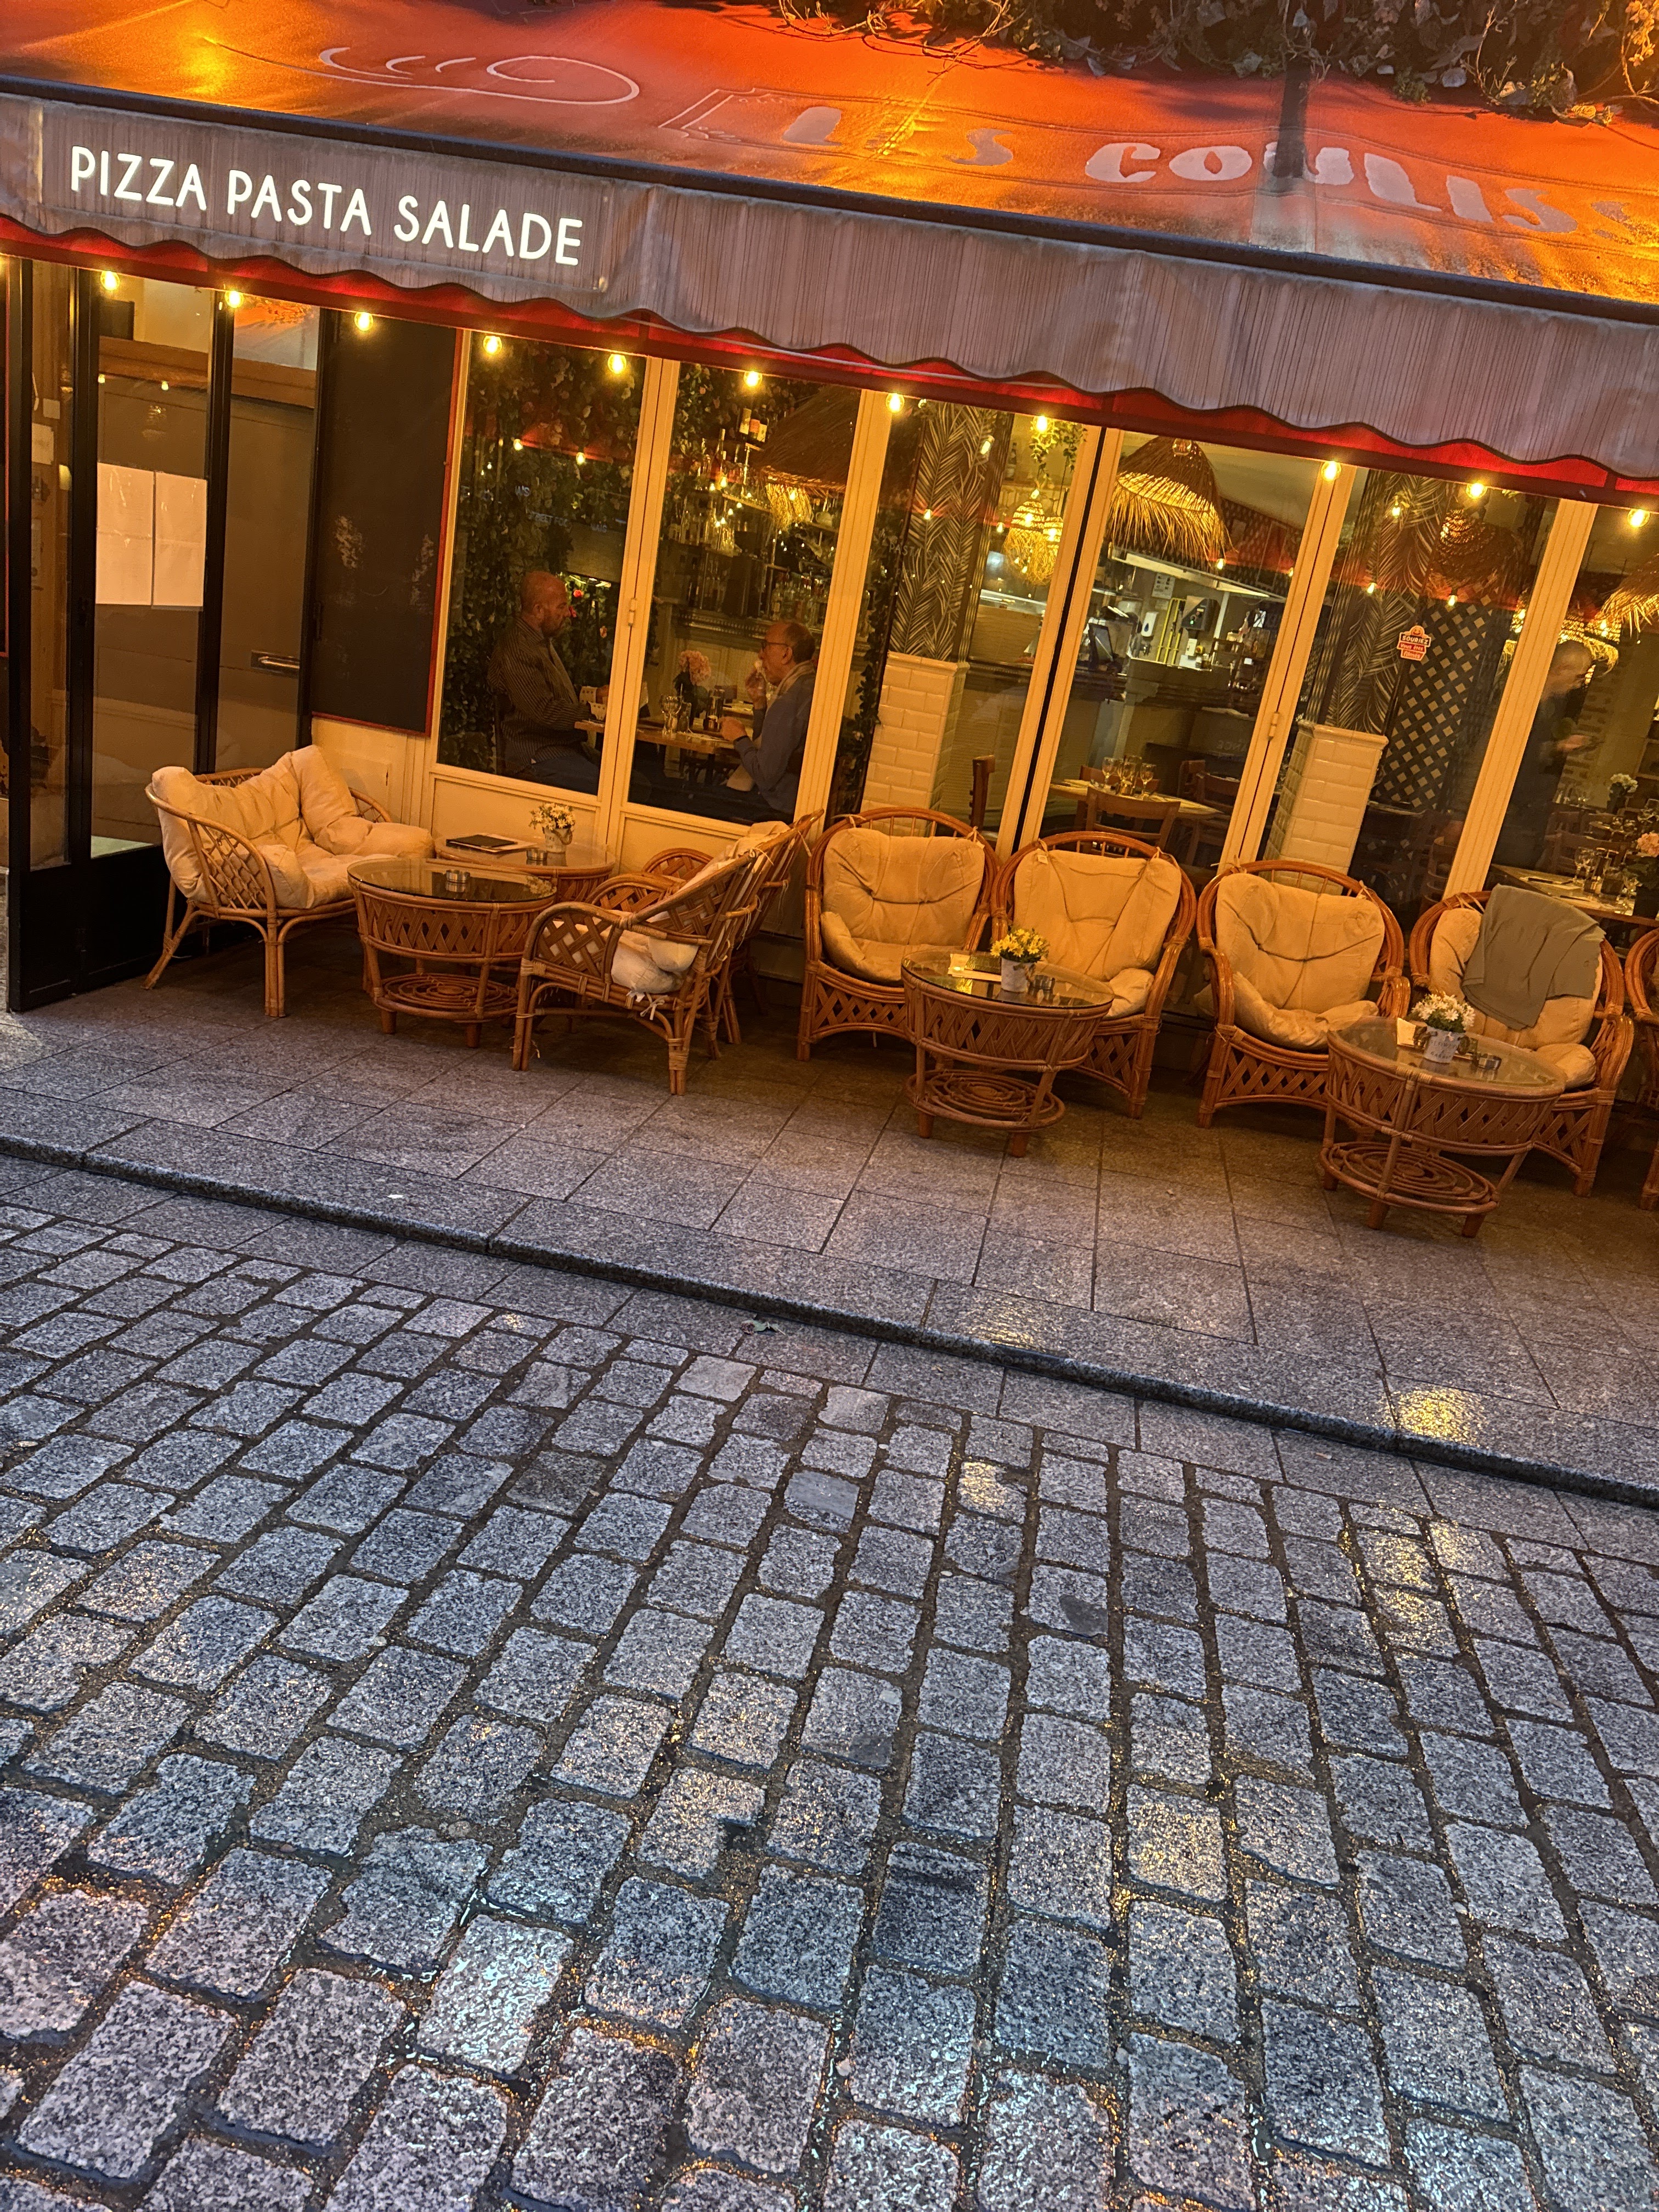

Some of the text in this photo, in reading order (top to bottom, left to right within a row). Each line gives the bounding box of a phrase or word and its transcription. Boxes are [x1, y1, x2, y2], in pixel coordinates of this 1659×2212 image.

[71, 145, 583, 266] PIZZA PASTA SALADE
[1402, 635, 1429, 645] SOURIEZ
